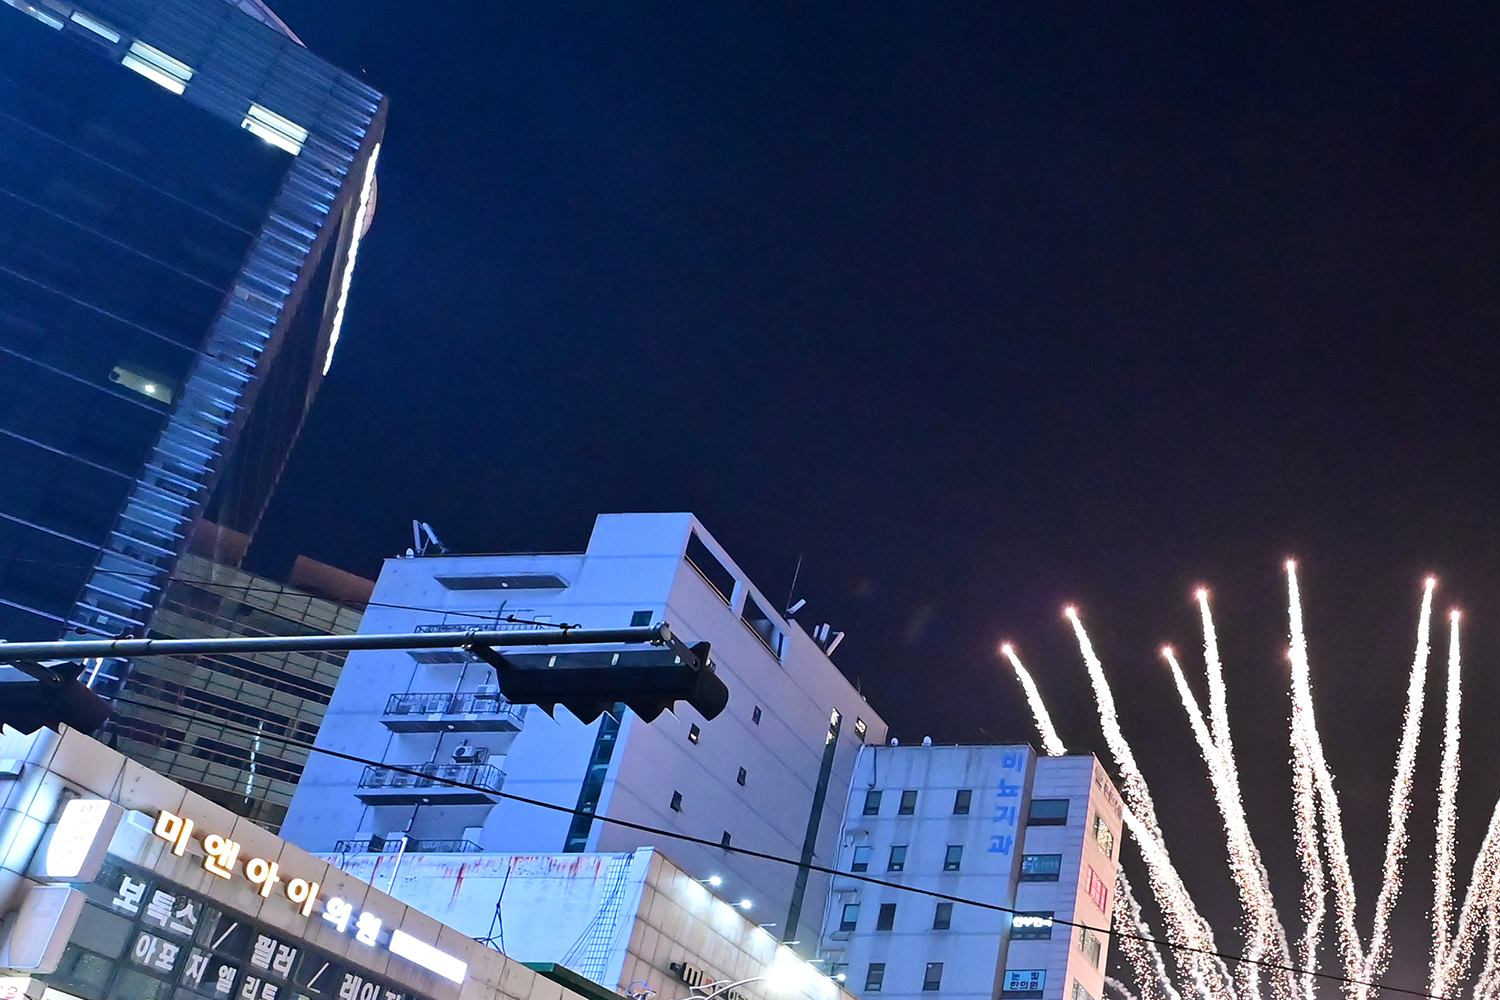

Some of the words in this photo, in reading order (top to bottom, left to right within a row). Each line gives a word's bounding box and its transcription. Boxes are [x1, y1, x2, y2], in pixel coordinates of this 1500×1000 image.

[987, 753, 1024, 856] 비뇨기과
[112, 875, 198, 936] 보톡스
[250, 934, 297, 979] 필러
